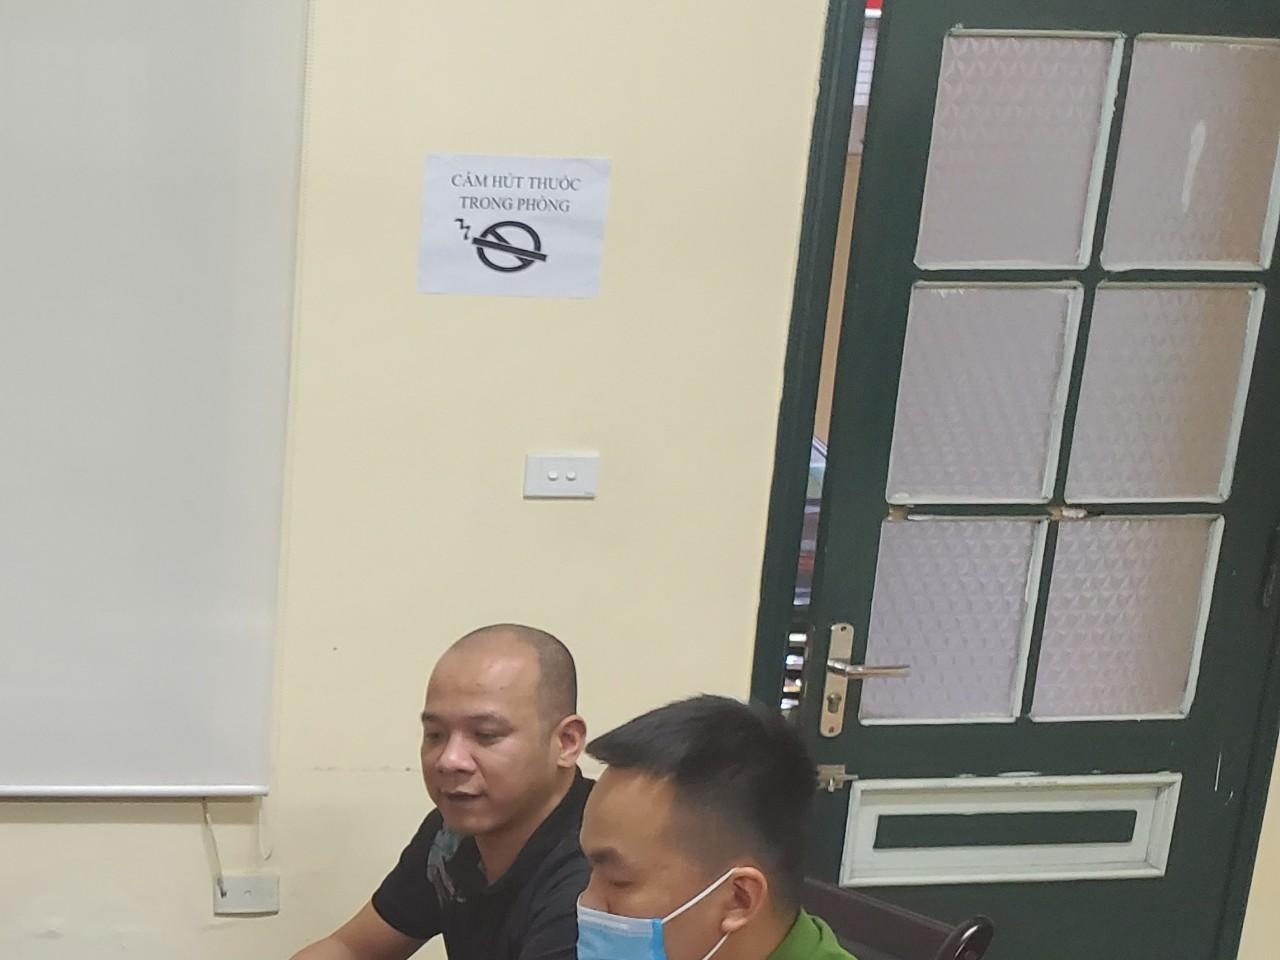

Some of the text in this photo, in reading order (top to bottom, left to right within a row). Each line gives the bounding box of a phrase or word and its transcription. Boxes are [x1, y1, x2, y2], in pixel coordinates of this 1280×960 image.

[492, 172, 524, 189] HÚT
[460, 194, 571, 213] TRONG PHÒNG
